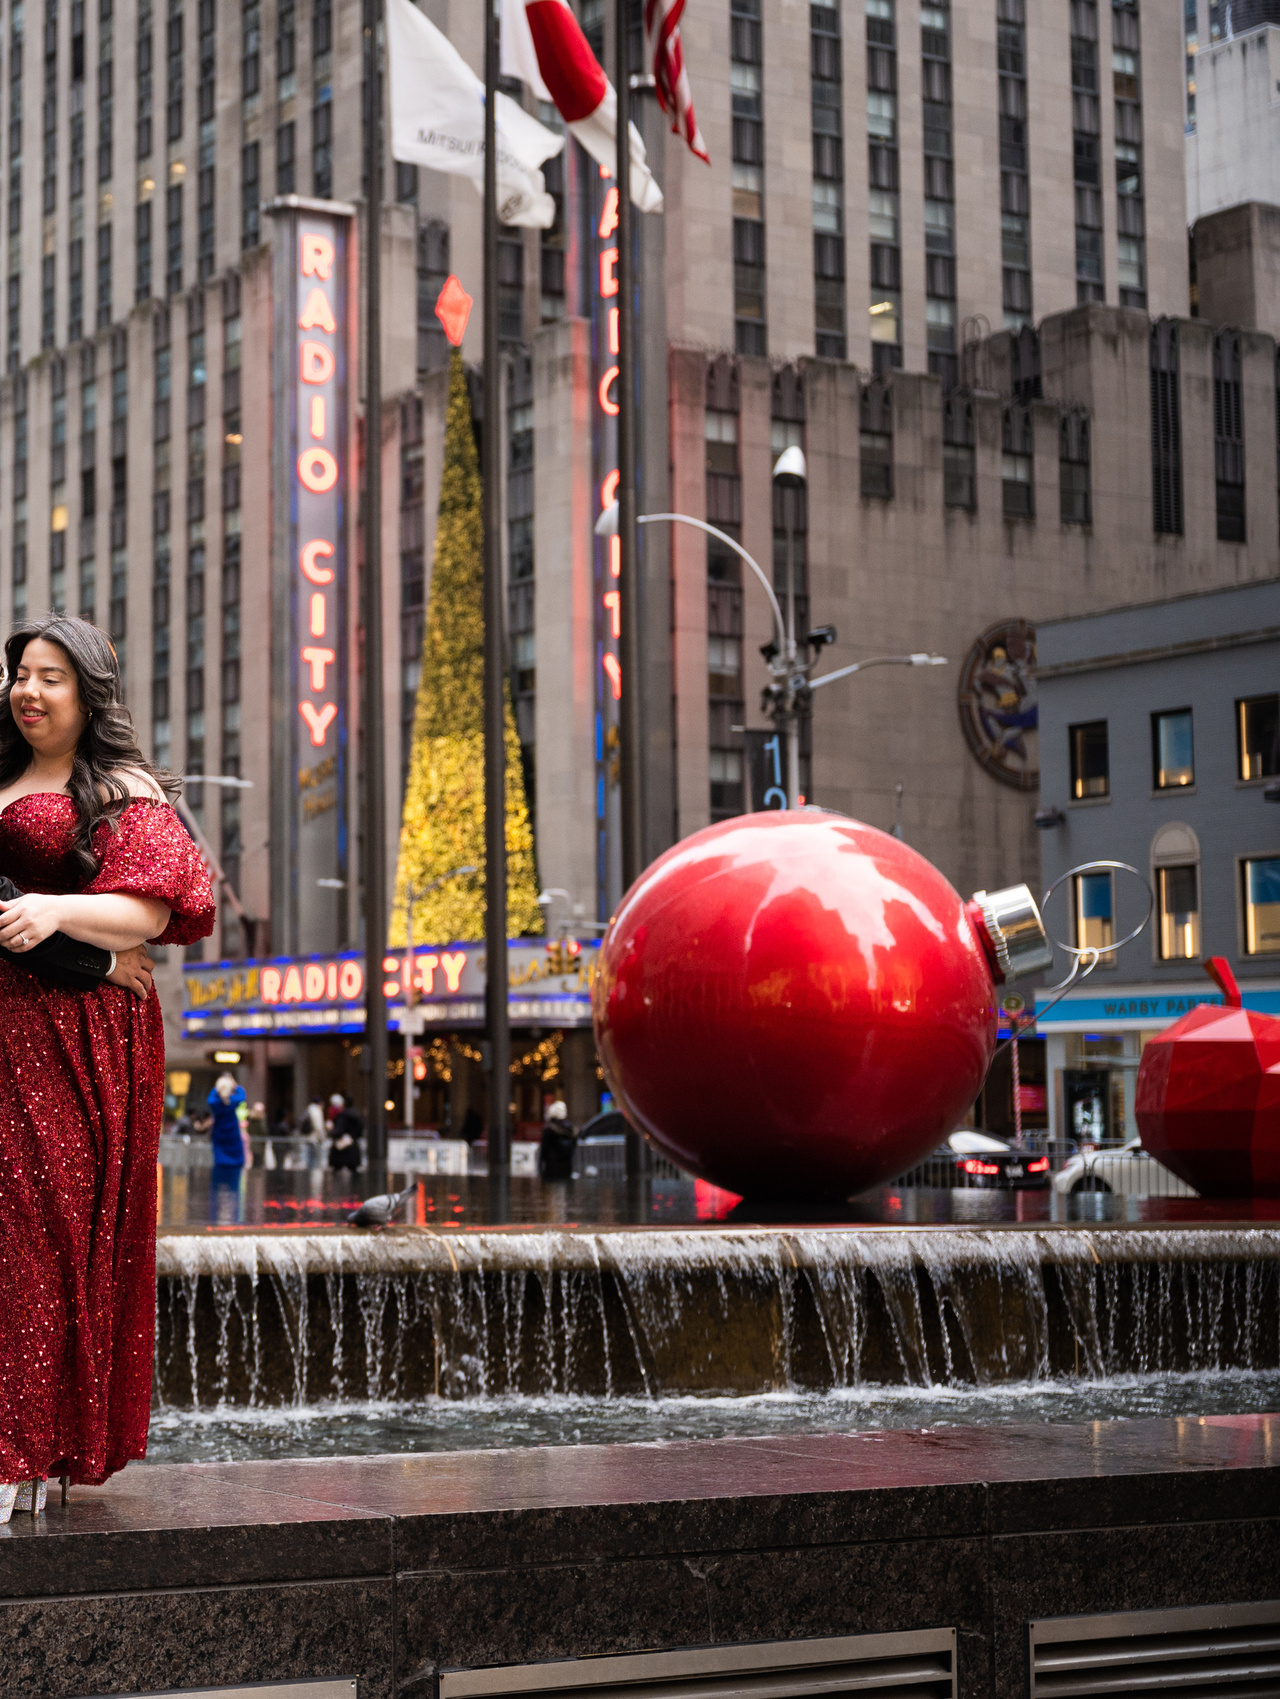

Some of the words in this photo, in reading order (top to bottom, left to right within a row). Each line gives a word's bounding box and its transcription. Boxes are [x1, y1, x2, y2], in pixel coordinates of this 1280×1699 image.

[297, 232, 338, 494] RADIO
[298, 538, 338, 747] CITY
[260, 960, 364, 1004] RADIO
[1103, 1001, 1159, 1015] WARBY
